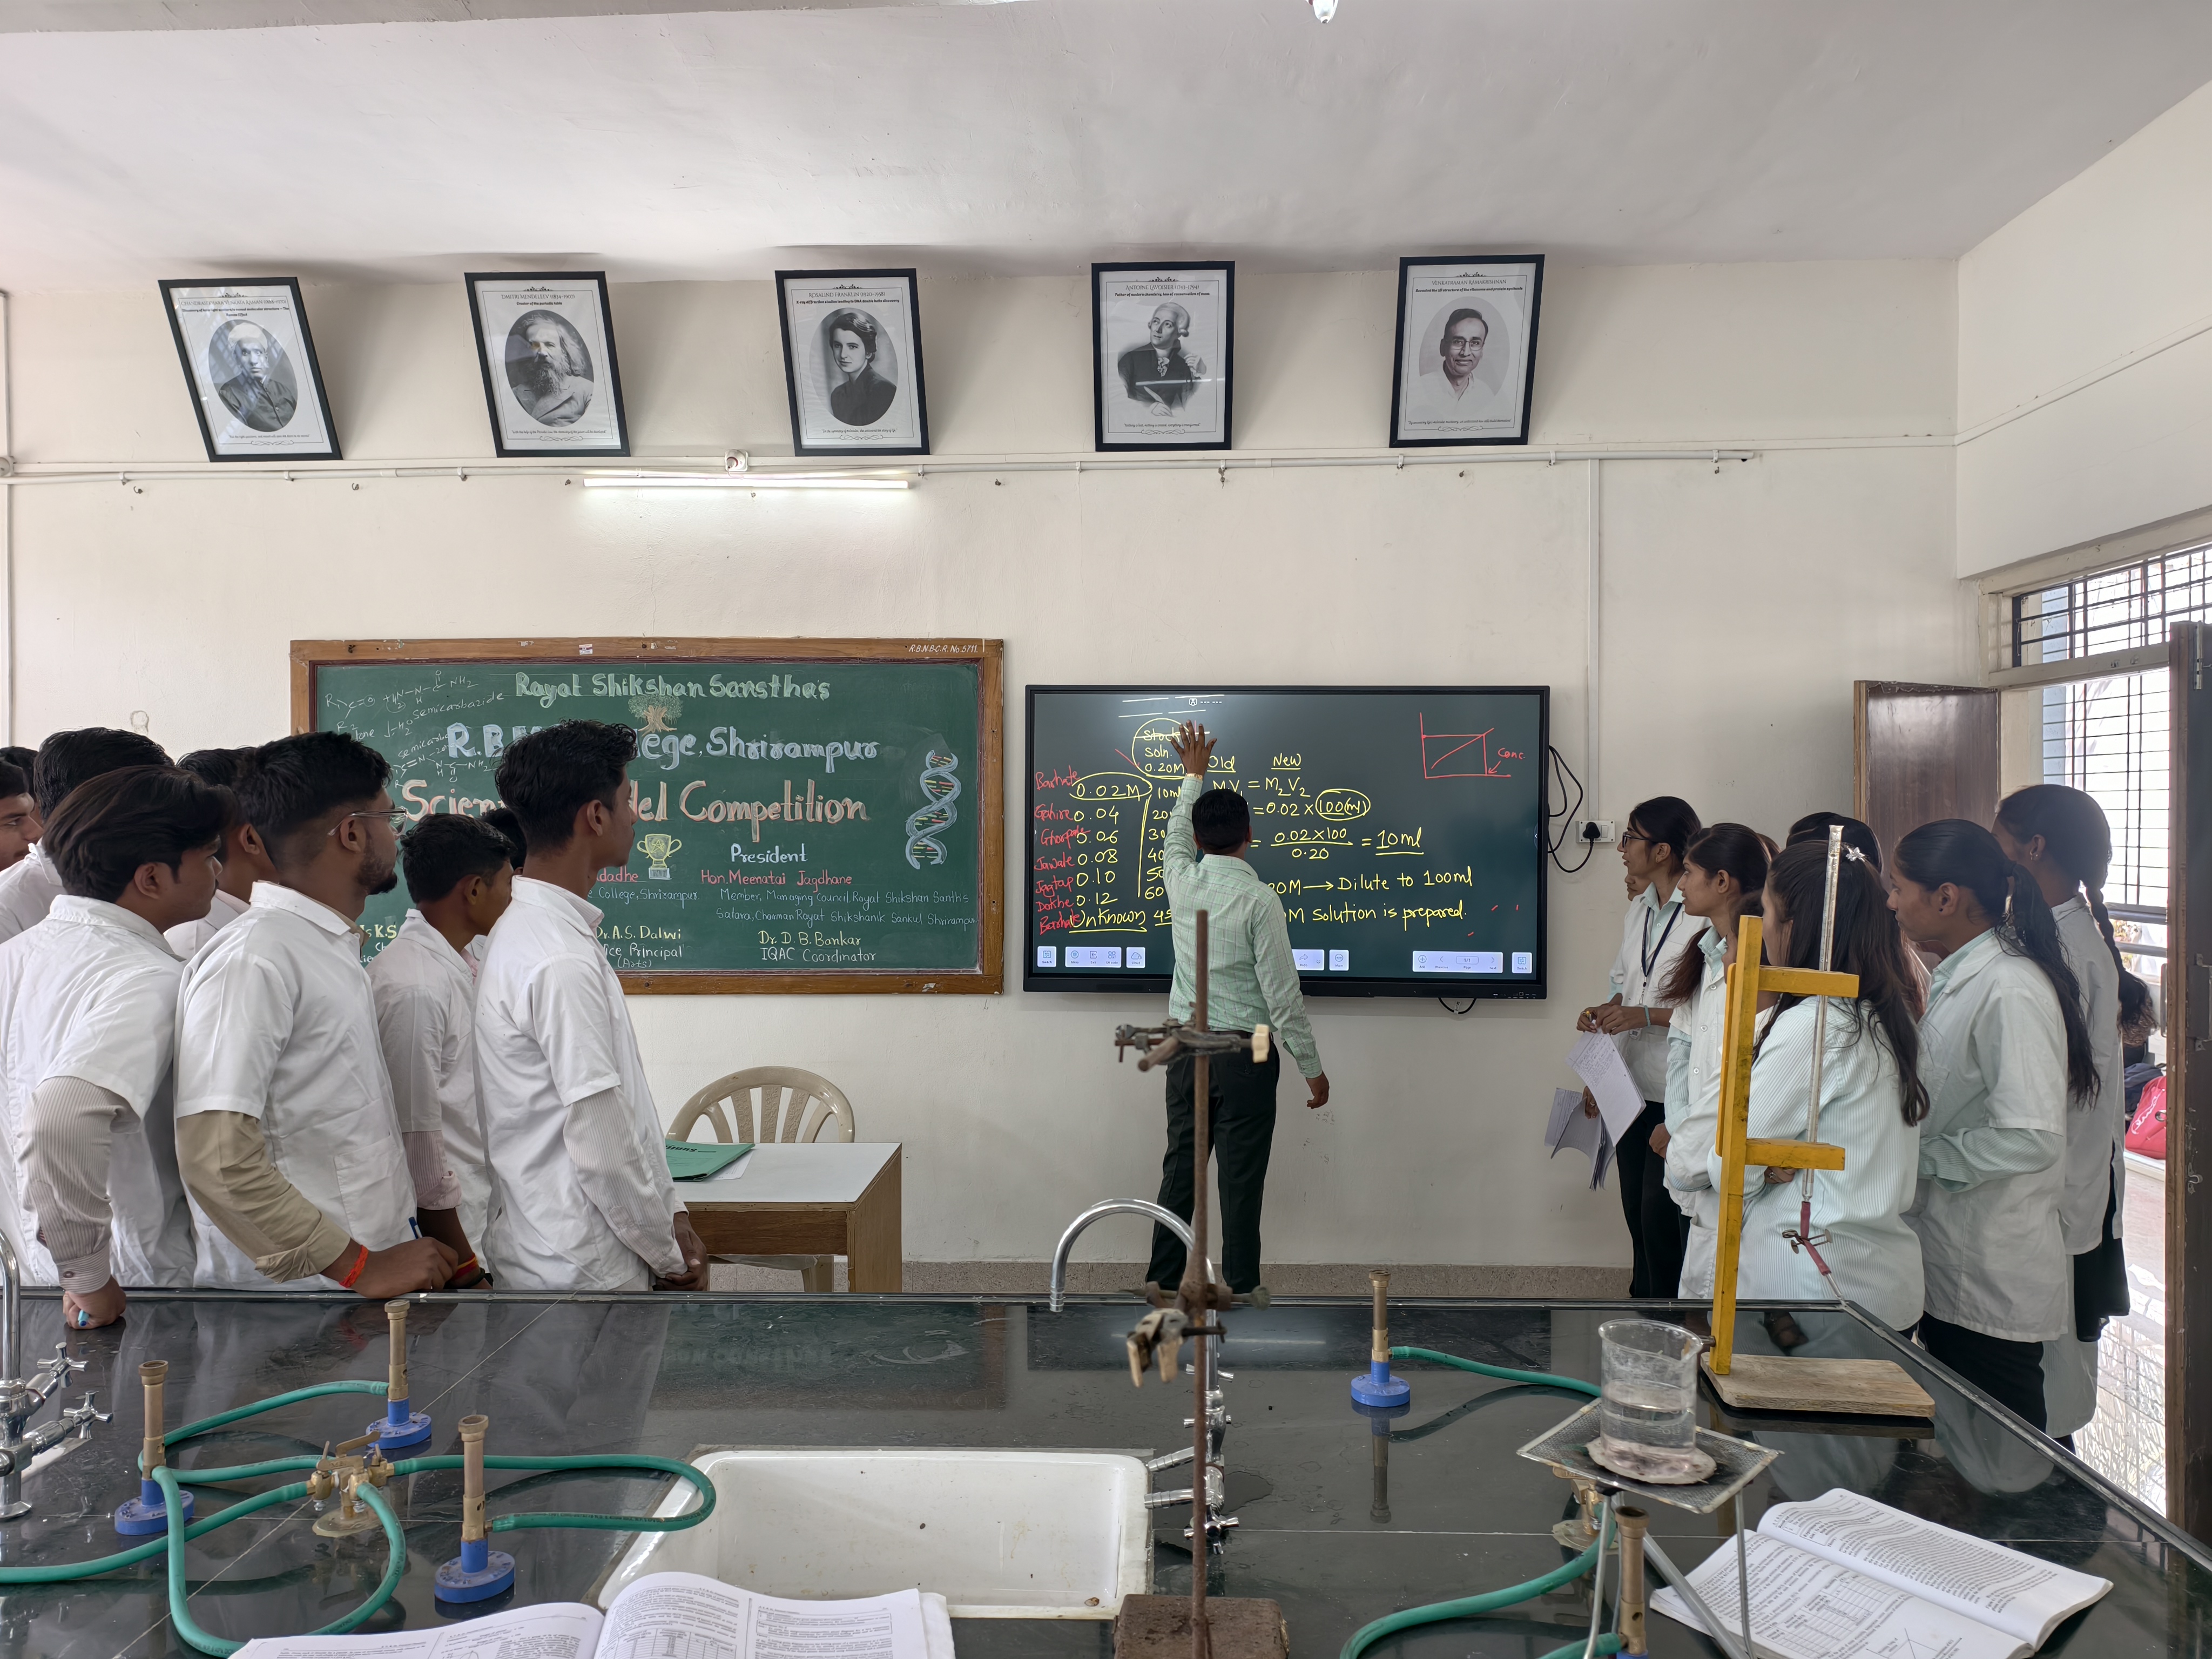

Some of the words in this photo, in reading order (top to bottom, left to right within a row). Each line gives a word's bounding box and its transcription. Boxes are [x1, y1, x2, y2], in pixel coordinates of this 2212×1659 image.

[516, 672, 582, 708] Rayat
[592, 672, 707, 698] Shikshan
[1208, 756, 1235, 770] Old
[1273, 753, 1301, 766] New
[1376, 826, 1422, 849] 10ml
[730, 842, 808, 864] President
[1077, 849, 1118, 865] 0.08
[1292, 848, 1329, 859] 0.20
[597, 865, 639, 882] dadhe
[797, 869, 852, 893] Jagdhane
[1076, 868, 1116, 886] 0.10
[1337, 873, 1390, 891] Dilute
[1397, 872, 1414, 887] to
[886, 891, 929, 903] Shikshan
[1076, 892, 1118, 906] 0.12
[1383, 903, 1398, 918] is
[640, 925, 682, 940] Dalwi
[815, 930, 861, 946] Bankar
[630, 942, 683, 960] Principal
[759, 947, 795, 961] IQAC
[802, 948, 876, 963] Coordinator
